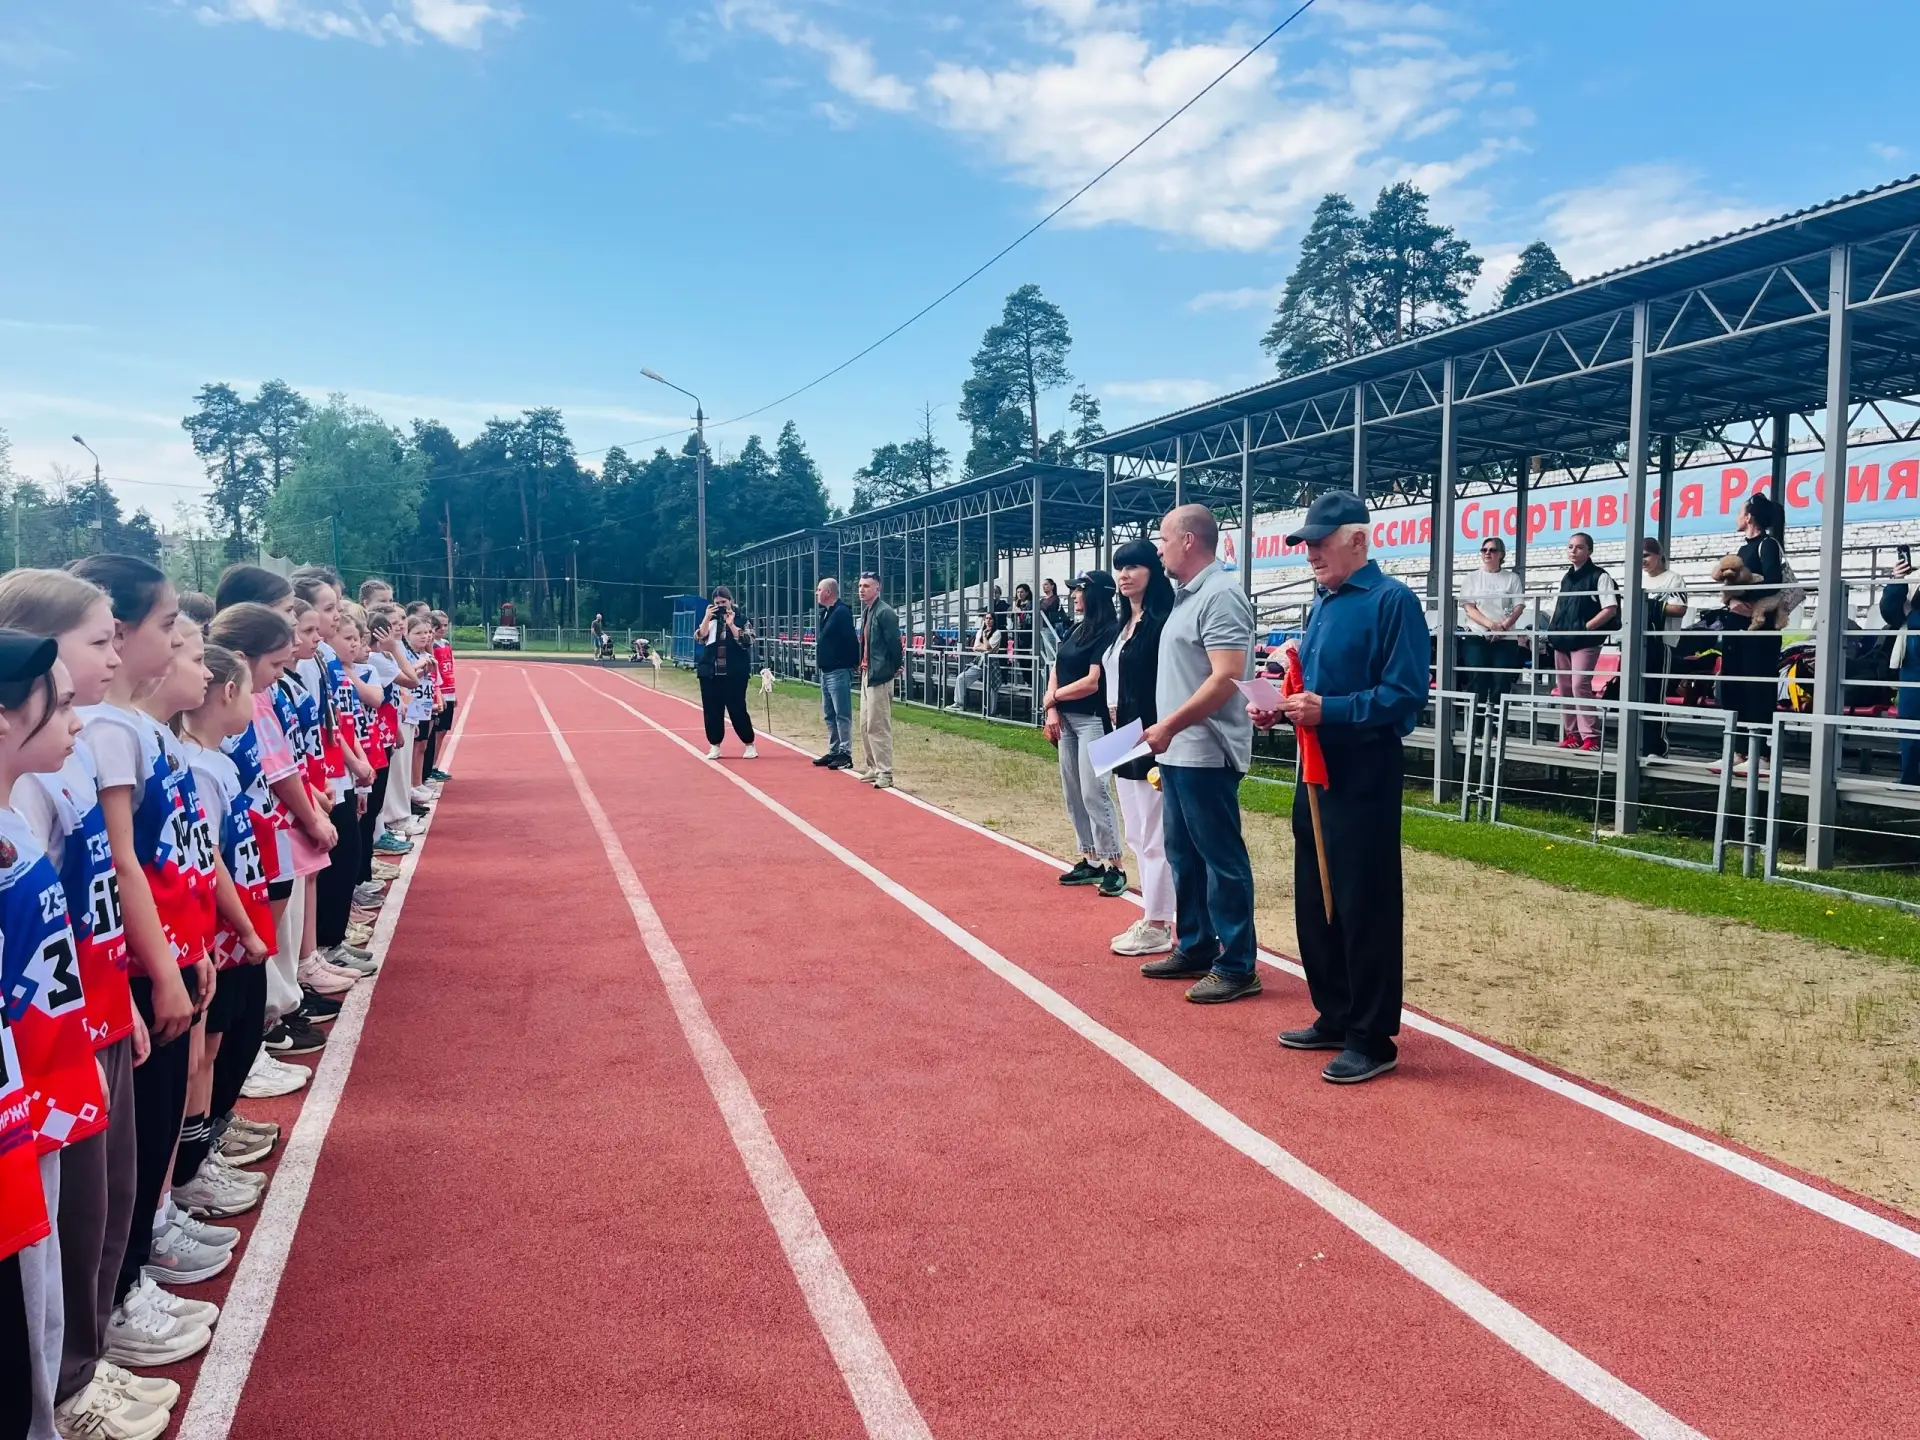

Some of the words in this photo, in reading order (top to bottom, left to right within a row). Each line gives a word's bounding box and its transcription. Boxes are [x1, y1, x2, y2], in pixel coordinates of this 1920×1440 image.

[1373, 516, 1432, 548] ссия
[1461, 484, 1704, 543] Спортивая
[43, 932, 83, 1010] 3
